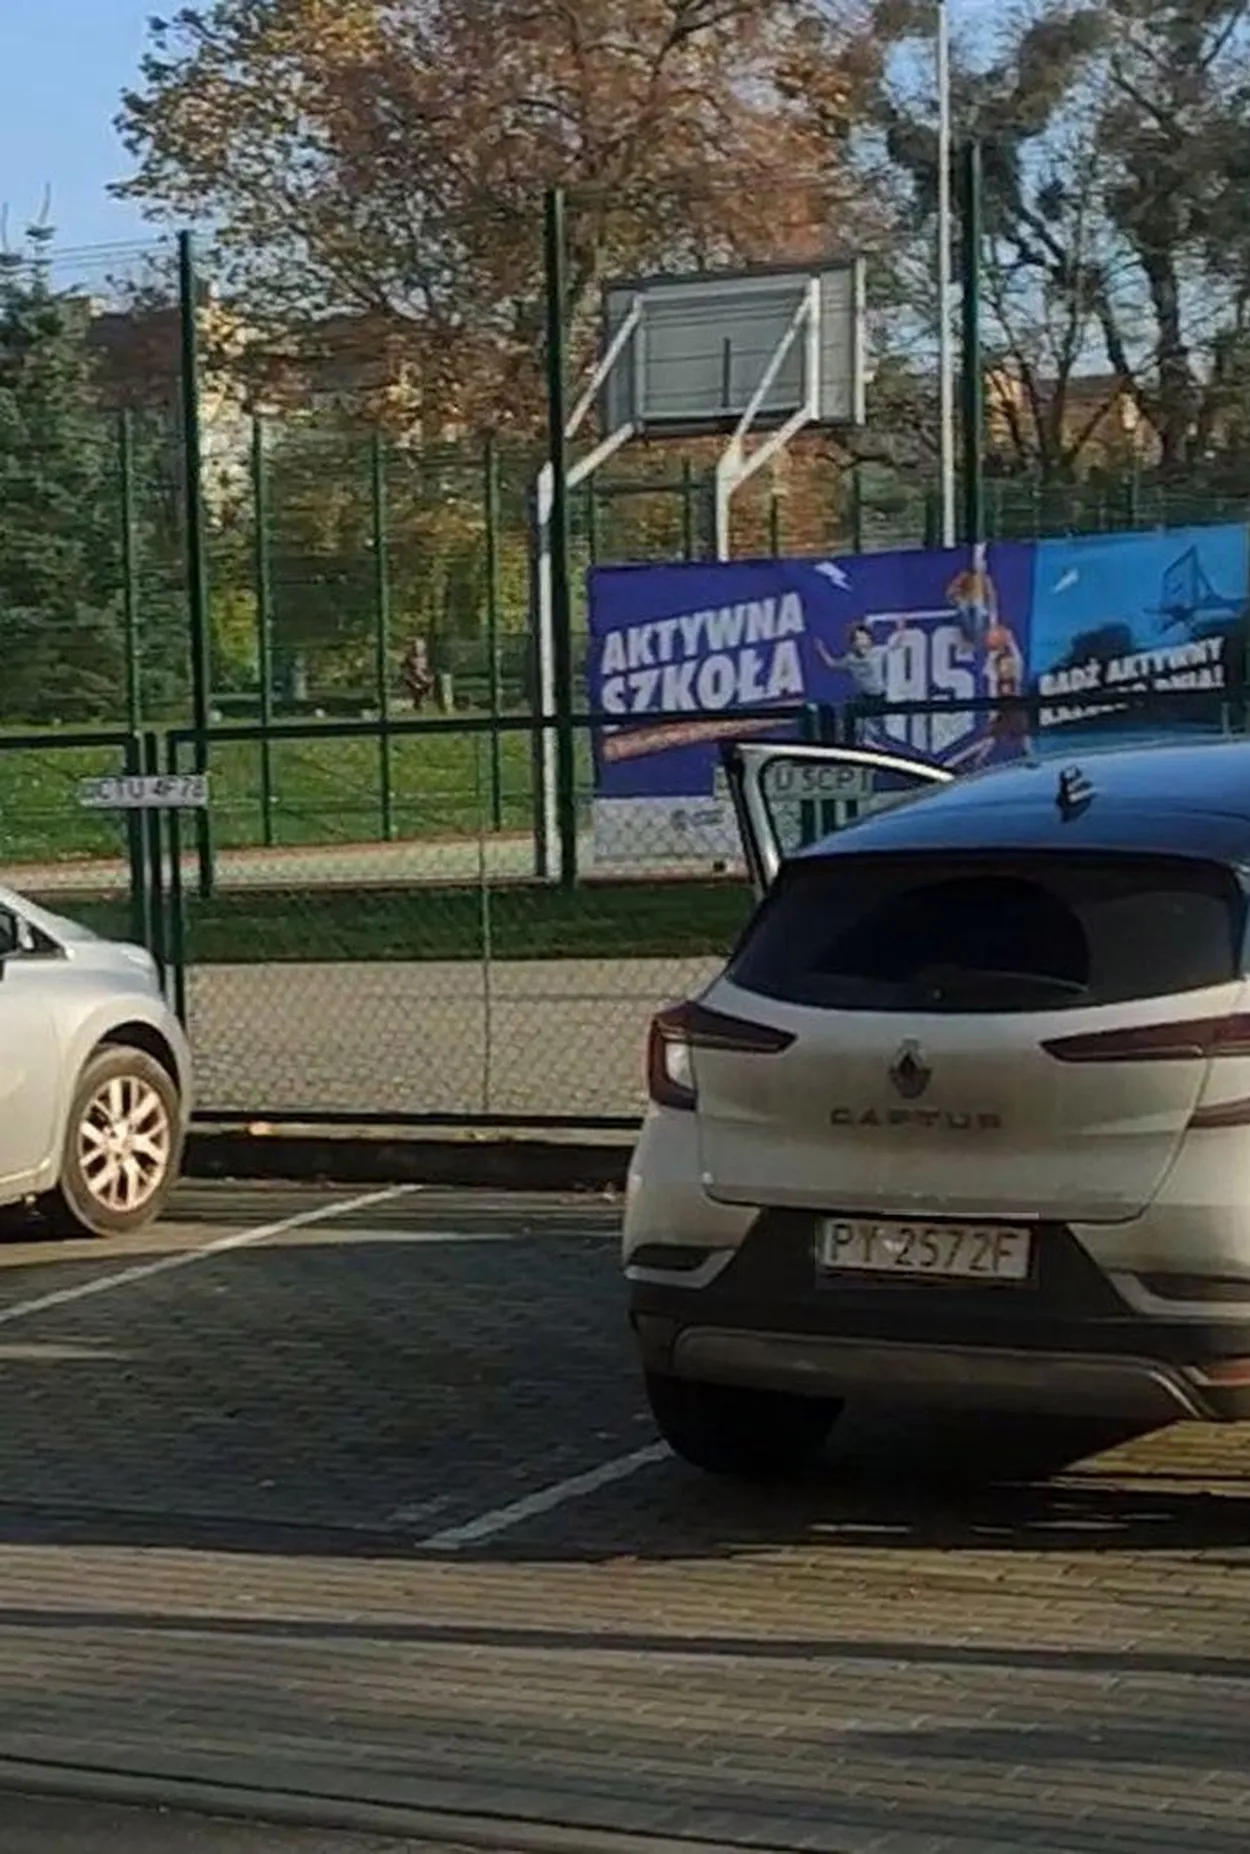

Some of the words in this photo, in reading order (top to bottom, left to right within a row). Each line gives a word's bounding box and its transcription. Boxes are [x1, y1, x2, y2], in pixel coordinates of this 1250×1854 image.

[601, 591, 805, 675] AKTYWNA
[601, 639, 805, 732] SZKOŁA
[830, 1107, 1005, 1130] CAPTUR
[831, 1223, 880, 1262] PY
[894, 1226, 1019, 1273] 2572F
